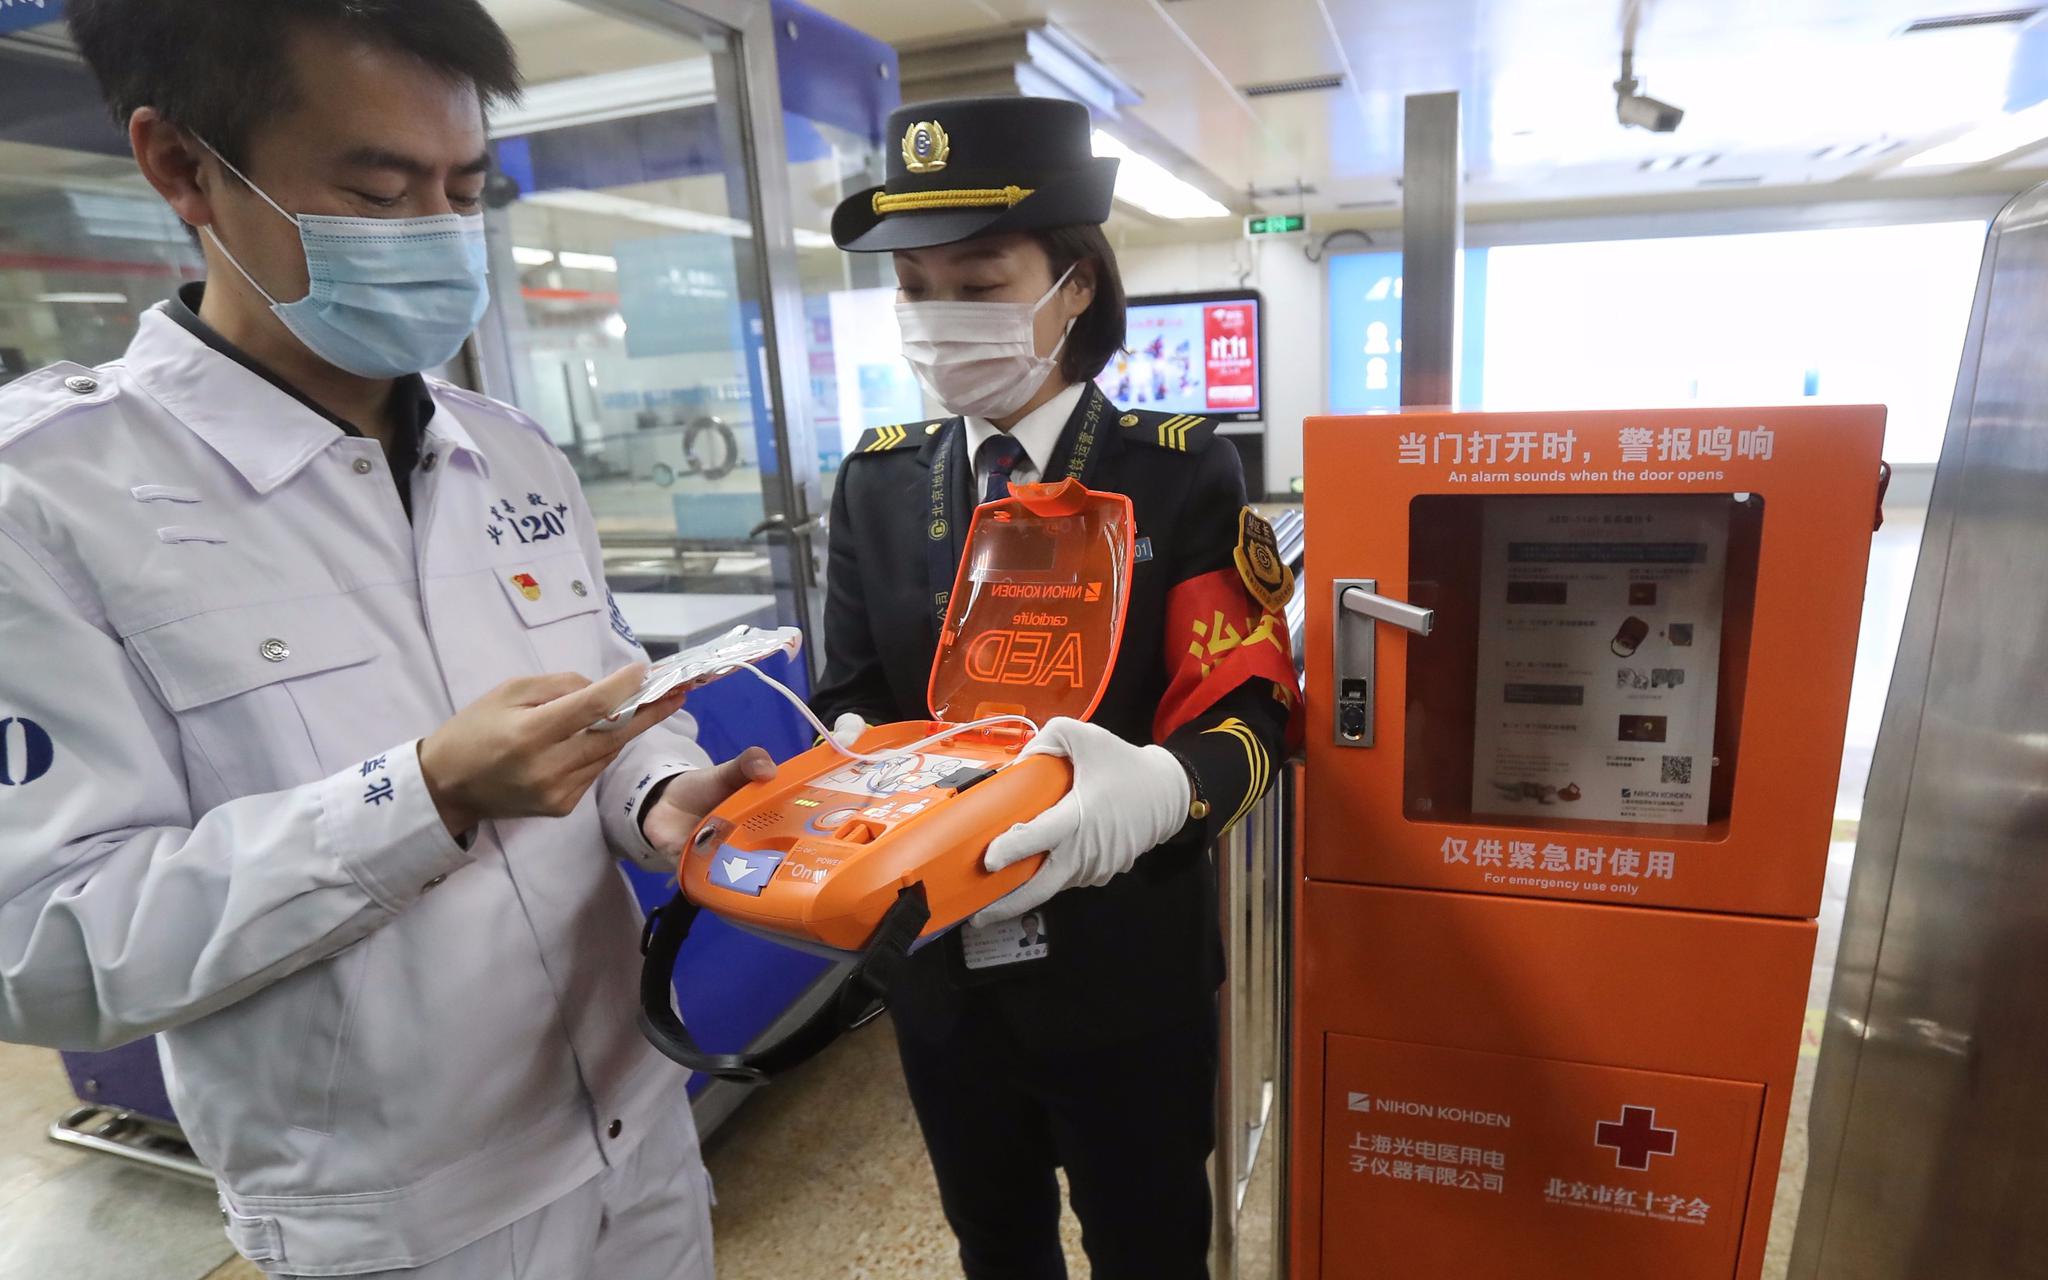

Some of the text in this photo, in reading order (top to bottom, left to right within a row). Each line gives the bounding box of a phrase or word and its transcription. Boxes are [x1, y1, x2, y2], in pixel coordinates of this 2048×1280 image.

[1398, 426, 1775, 465] 当门打开时，警报鸣响
[1448, 469, 1724, 483] An alarm sounds when the door opens
[507, 510, 566, 544] 120
[1440, 836, 1676, 880] 仅供紧急时使用
[1484, 872, 1640, 896] For emergency use only
[1376, 1098, 1512, 1128] NIHON KOHDEN
[1348, 1132, 1506, 1170] 上海光电医用电
[1348, 1154, 1505, 1194] 子仪器有限公司
[1543, 1177, 1712, 1219] 北京市红十字会
